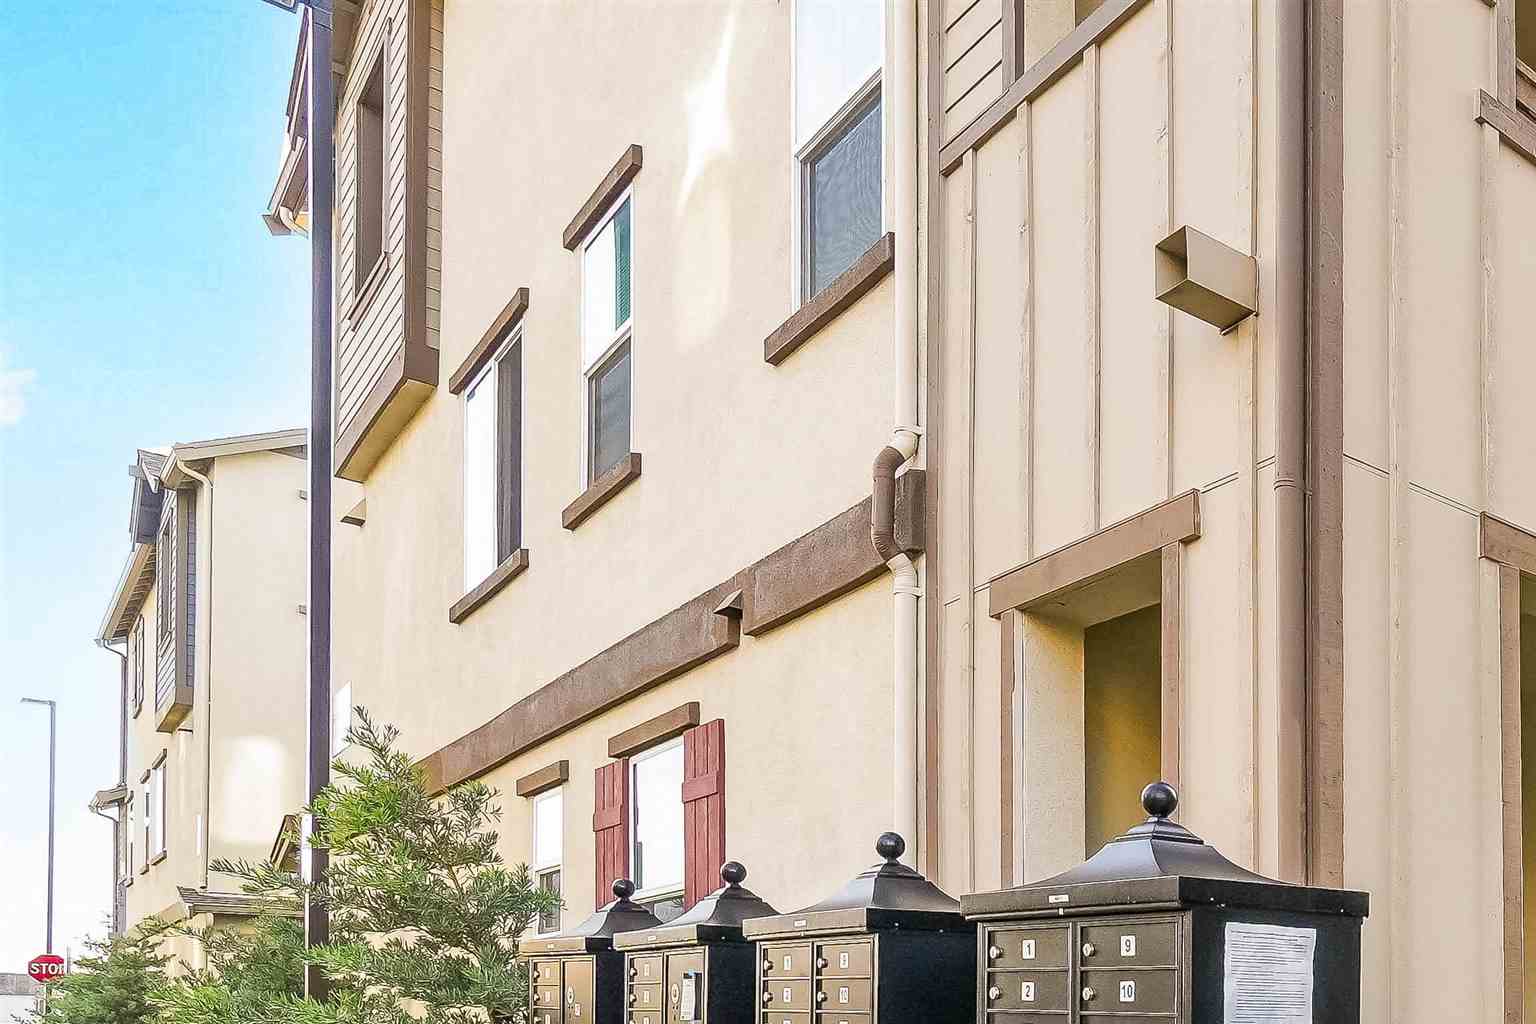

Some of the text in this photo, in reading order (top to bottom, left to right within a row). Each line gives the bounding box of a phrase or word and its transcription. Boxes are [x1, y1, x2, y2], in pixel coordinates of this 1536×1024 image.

[1025, 943, 1031, 956] 1
[1125, 938, 1131, 953] 9
[1025, 984, 1031, 998] 2
[1121, 984, 1133, 998] 10
